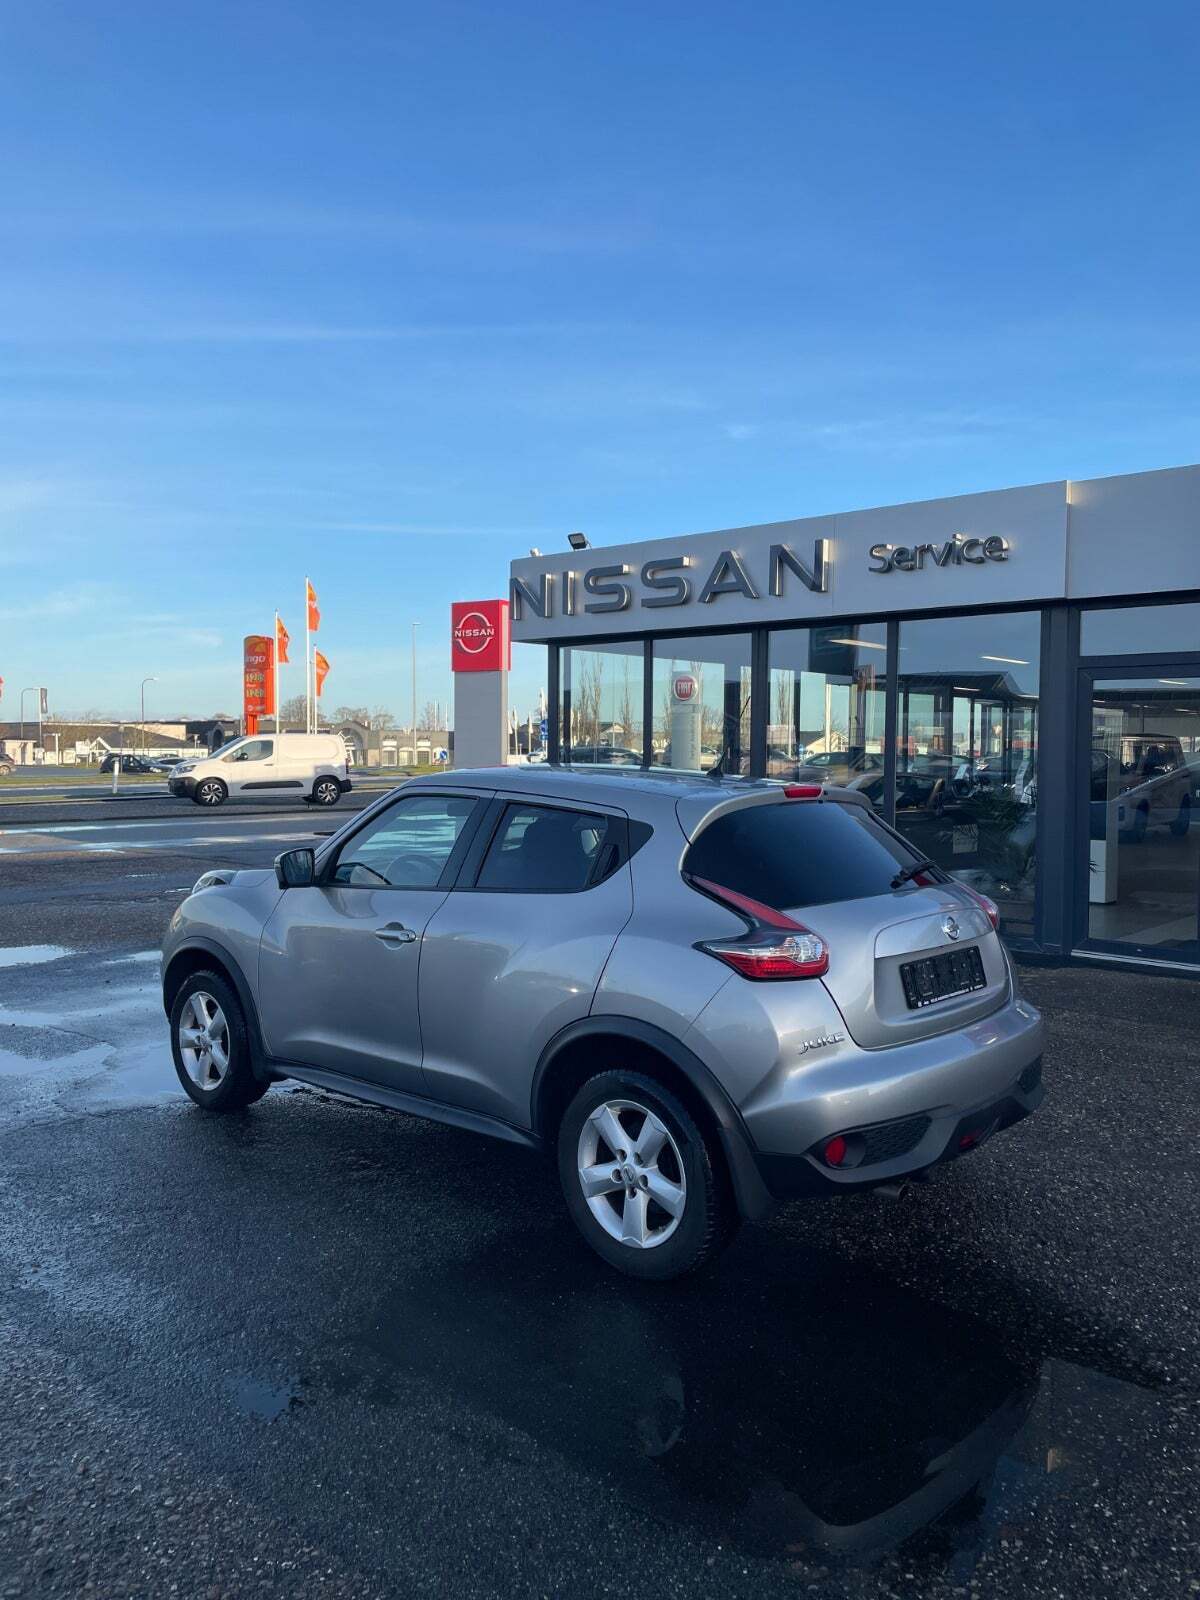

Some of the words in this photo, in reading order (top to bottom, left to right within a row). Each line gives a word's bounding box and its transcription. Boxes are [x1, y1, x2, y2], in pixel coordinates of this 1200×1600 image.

[509, 538, 831, 621] NISSAN
[868, 533, 1009, 574] Service
[454, 628, 495, 638] NISSAN
[677, 681, 693, 693] FIAT
[799, 1031, 846, 1055] JUKE
